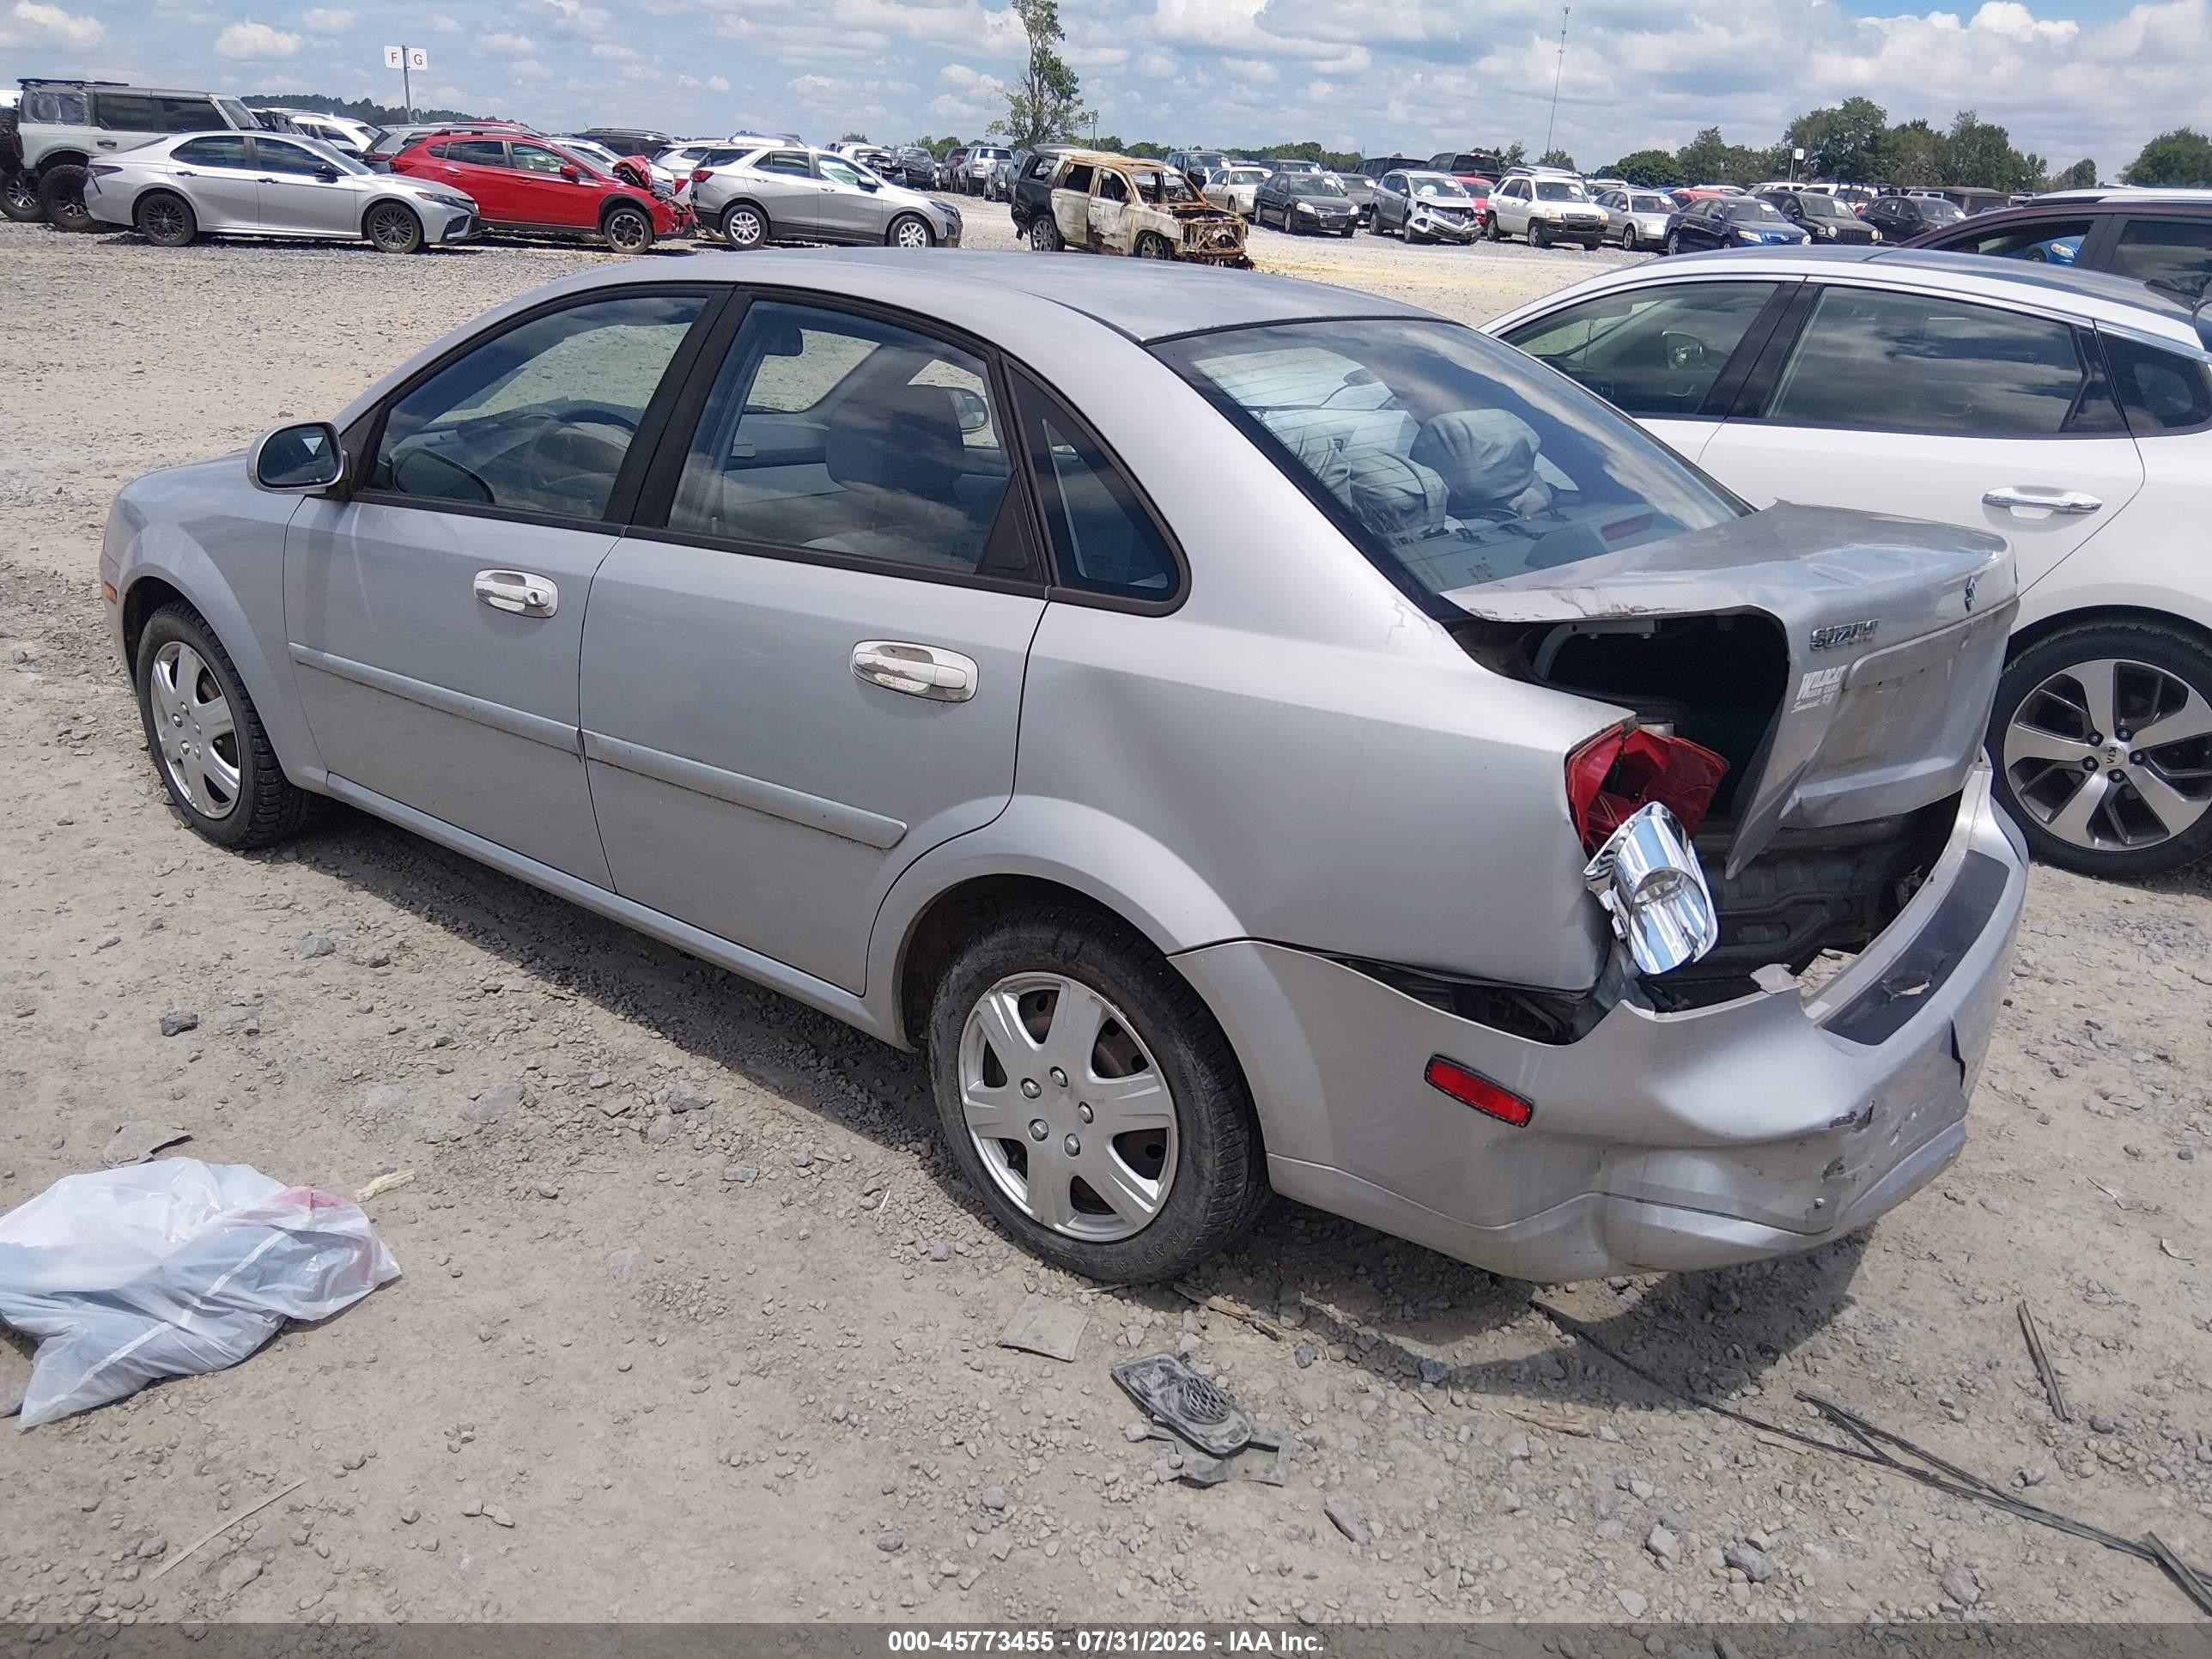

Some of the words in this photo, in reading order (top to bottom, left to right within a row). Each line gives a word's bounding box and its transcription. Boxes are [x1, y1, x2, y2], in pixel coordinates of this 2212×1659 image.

[391, 52, 398, 63] F
[413, 54, 423, 65] G
[2106, 746, 2117, 763] KIA
[1104, 1229, 1182, 1273] RADIAL
